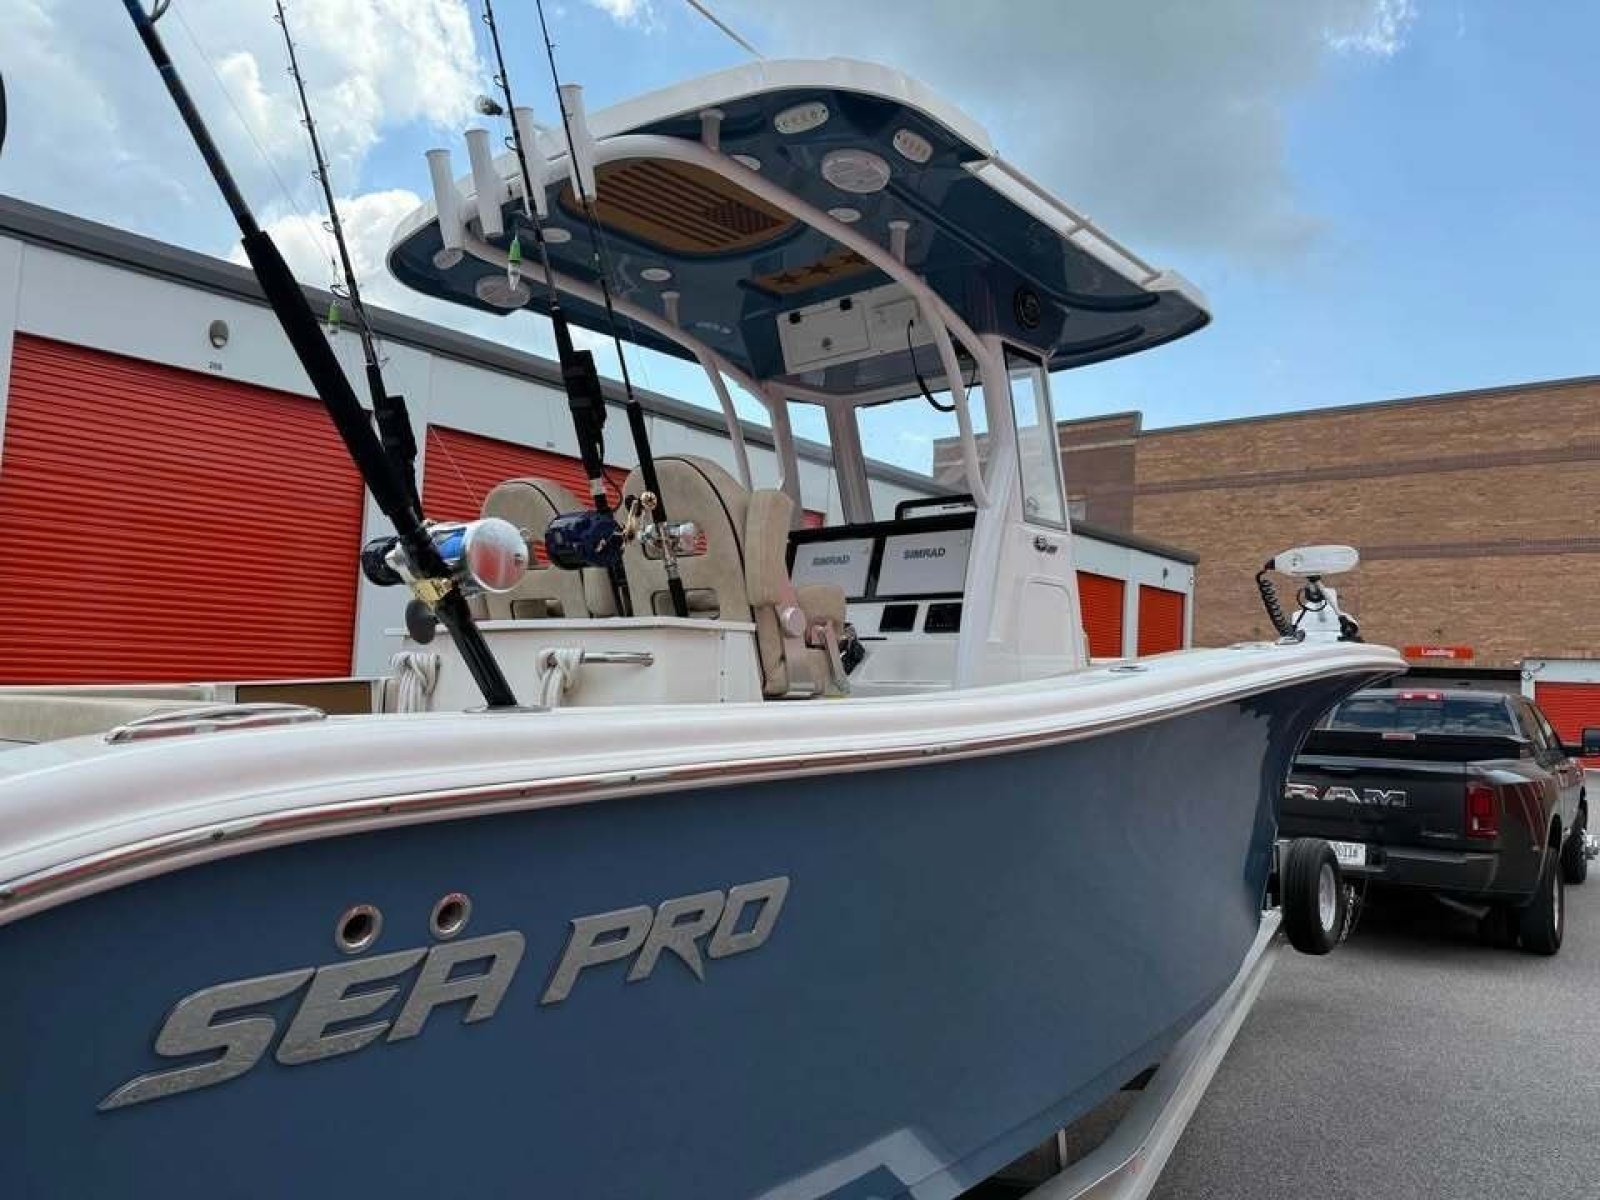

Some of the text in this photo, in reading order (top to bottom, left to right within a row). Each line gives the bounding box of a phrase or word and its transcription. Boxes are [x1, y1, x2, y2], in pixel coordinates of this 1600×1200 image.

[904, 547, 945, 560] SIMRAD
[1421, 646, 1455, 658] Loading
[1284, 783, 1410, 808] RAM
[98, 875, 790, 1112] SEA PRO
